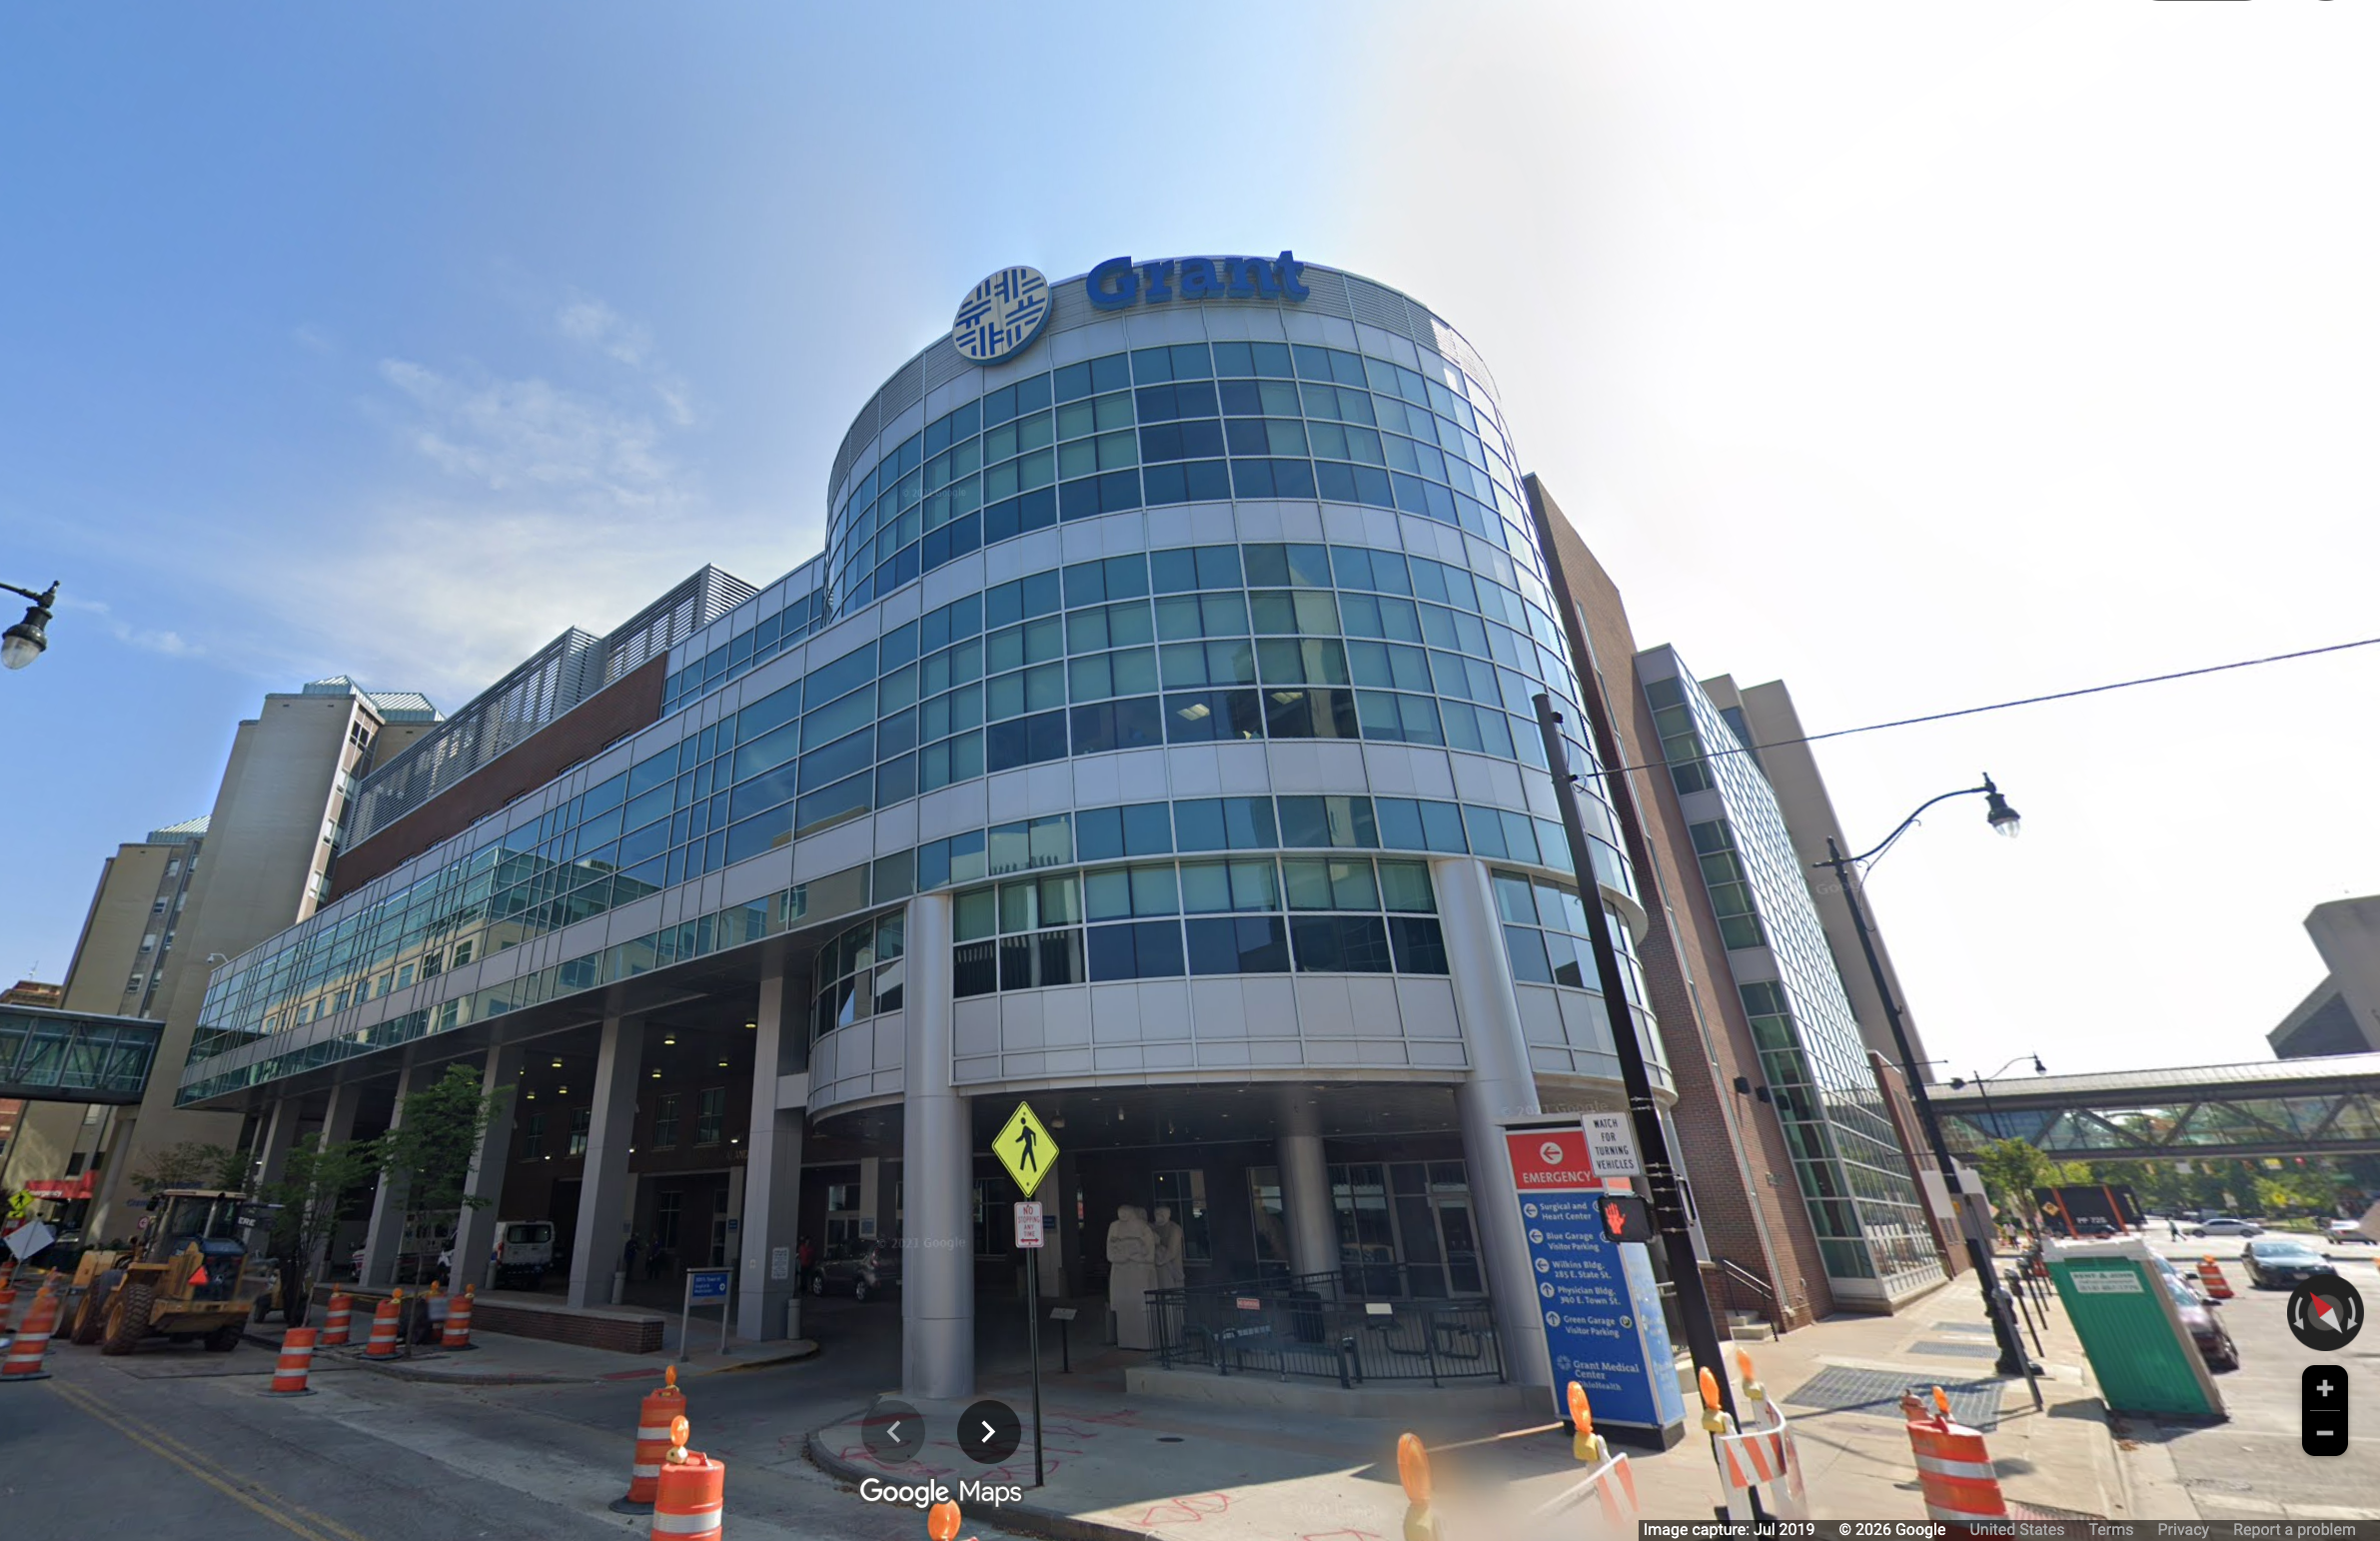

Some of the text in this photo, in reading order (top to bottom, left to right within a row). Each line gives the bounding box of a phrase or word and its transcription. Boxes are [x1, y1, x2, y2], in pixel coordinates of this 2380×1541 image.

[1086, 250, 1310, 311] Grant
[1593, 1119, 1618, 1128] WATCH
[1601, 1132, 1616, 1142] FOR
[1595, 1146, 1629, 1156] TURNING
[1596, 1159, 1634, 1170] VEHICLES
[1523, 1171, 1592, 1184] EMERGENCY
[1023, 1207, 1034, 1215] NO
[1540, 1202, 1571, 1212] Surgical
[1565, 1233, 1594, 1242] Garage
[1548, 1242, 1600, 1252] Visitor Parking
[1552, 1260, 1605, 1271] Wilkins Bldg.
[1557, 1286, 1616, 1297] Physician Bldg.
[1585, 1296, 1607, 1305] Town
[1609, 1297, 1621, 1306] St.
[1564, 1315, 1586, 1324] Green
[1587, 1316, 1615, 1328] Garage
[1566, 1326, 1620, 1339] Visitor Parking
[1573, 1360, 1640, 1374] Grant Medical
[1575, 1370, 1606, 1380] Center
